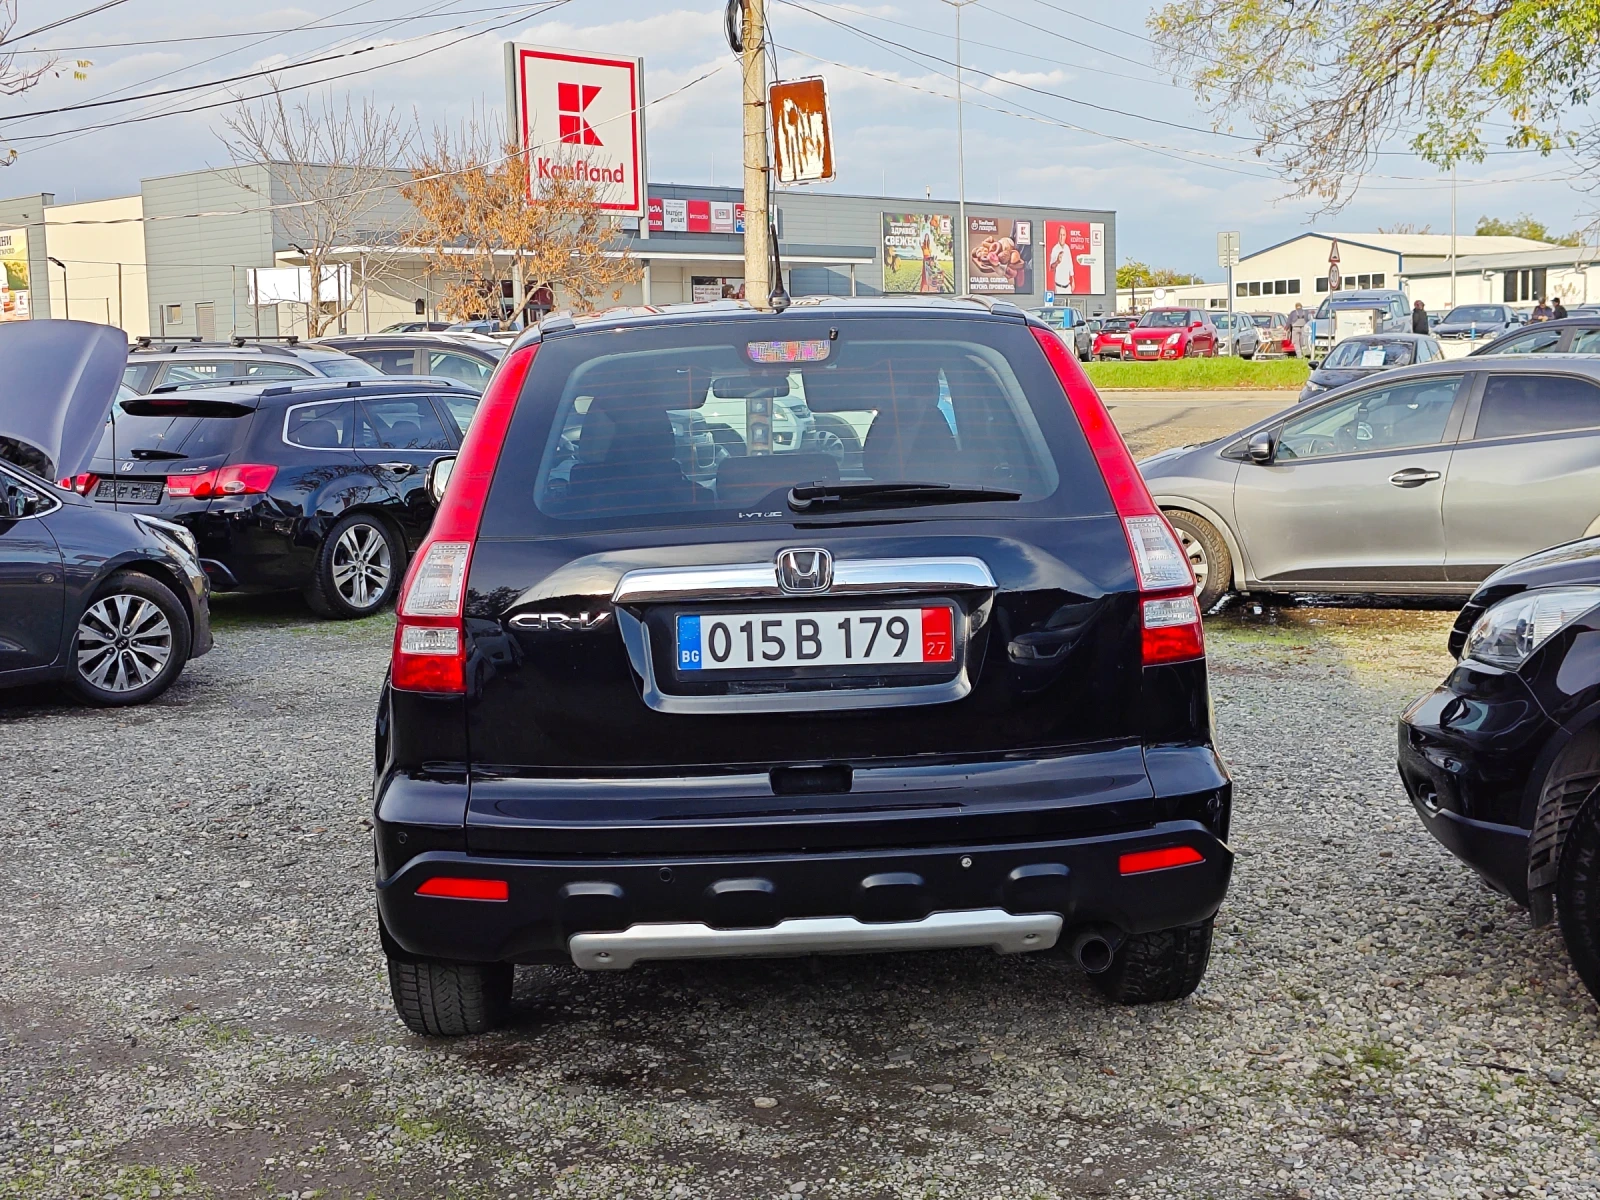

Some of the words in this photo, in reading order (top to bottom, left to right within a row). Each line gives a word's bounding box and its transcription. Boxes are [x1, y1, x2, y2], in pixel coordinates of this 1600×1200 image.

[537, 157, 625, 183] Kaufland
[508, 610, 611, 630] CR-V
[681, 650, 700, 663] BG
[837, 615, 911, 659] 179
[926, 641, 947, 656] 27
